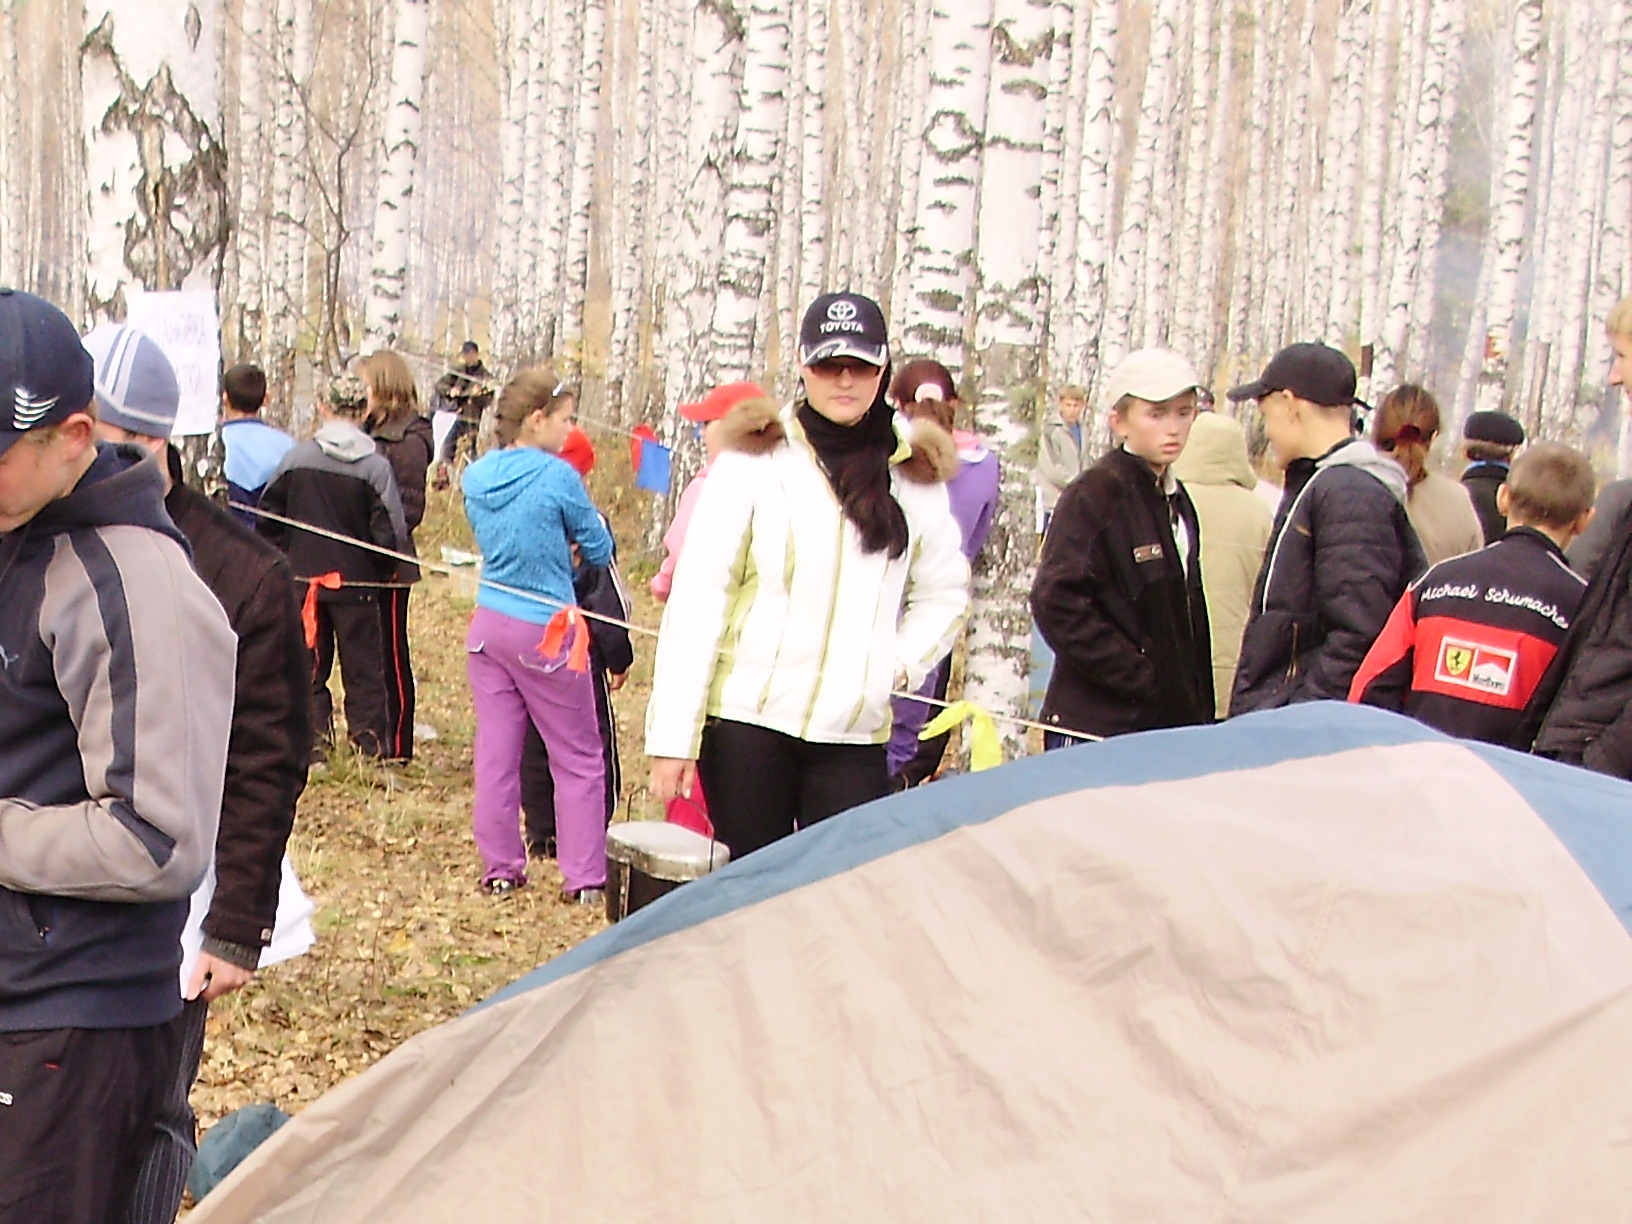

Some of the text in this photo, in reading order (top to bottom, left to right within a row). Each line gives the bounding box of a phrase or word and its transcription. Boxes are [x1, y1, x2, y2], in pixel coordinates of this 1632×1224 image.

[820, 321, 864, 334] TOYOTA
[1421, 584, 1569, 629] Michael Schumache
